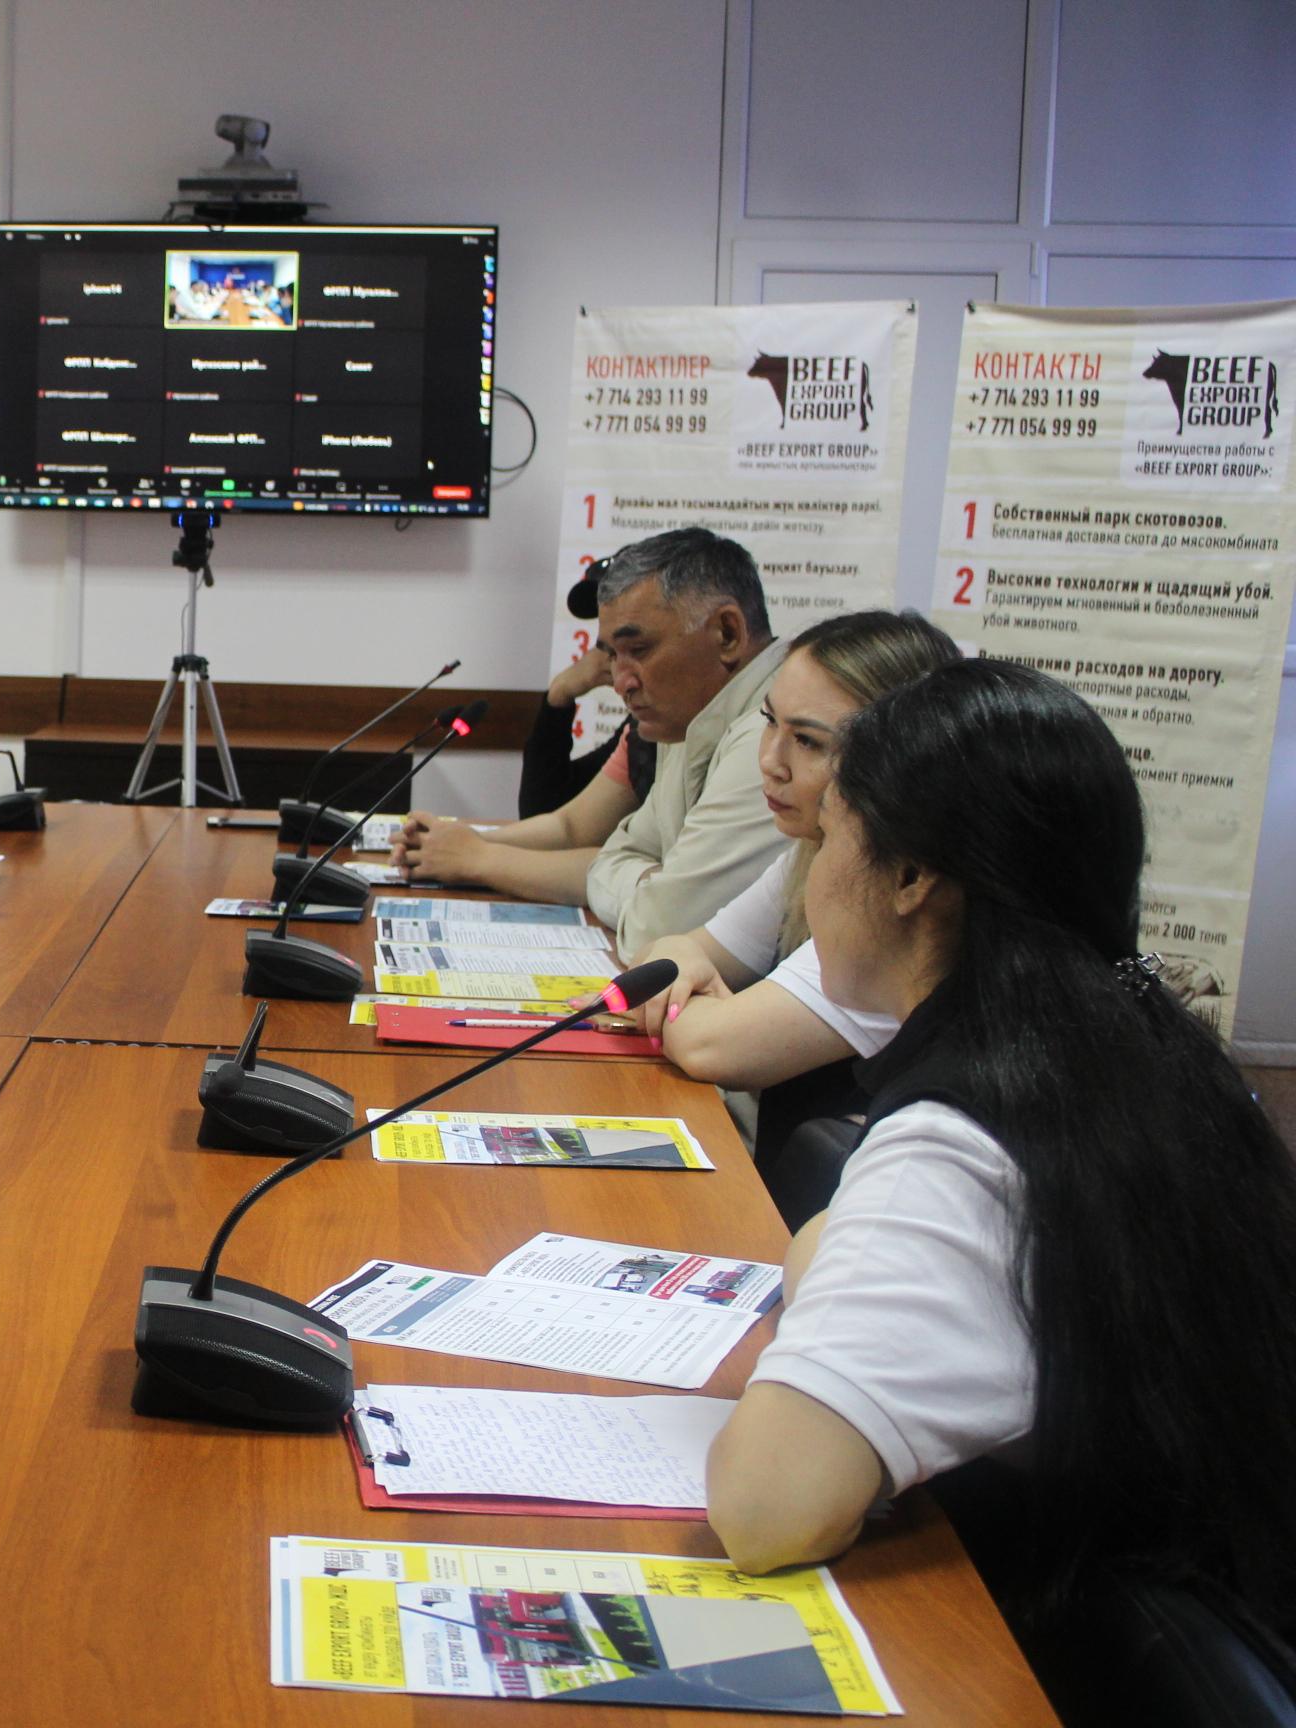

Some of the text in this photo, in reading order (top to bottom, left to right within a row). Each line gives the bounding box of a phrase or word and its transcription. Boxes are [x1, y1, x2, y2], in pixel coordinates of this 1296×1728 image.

[586, 354, 711, 379] КОНТАКТІЛЕР
[792, 356, 857, 381] BEEF
[974, 353, 1102, 381] КОНТАКТЫ
[1192, 356, 1263, 384] BEEF
[585, 388, 708, 406] +7 714 293 11 99
[791, 384, 856, 399] EXPORT
[970, 389, 1100, 407] +7 714 293 11 99
[1189, 387, 1262, 404] EXPORT
[790, 402, 856, 420] GROUP
[1187, 406, 1261, 427] GROUP
[584, 415, 707, 433] +7 771 054 99 99
[966, 418, 1097, 436] +7 771 054 99 99
[737, 443, 879, 458] «BEEF EXPORT GROUP»
[1137, 441, 1275, 461] Преимущества работы с
[1135, 462, 1170, 476] «BEEF
[1175, 462, 1218, 476] EXPORT
[584, 494, 596, 529] 1
[964, 502, 977, 539] 1
[994, 502, 1228, 529] Собственный парк скотовозов.
[992, 526, 1278, 551] Бесплатная доставка скота до мясокомбината
[952, 567, 975, 605] 2
[987, 568, 1274, 603] Высокие технологии и щадящий убой.
[985, 590, 1259, 620] Гарантируем мгновенный и безболезненный
[983, 612, 1080, 634] убой животного.
[1075, 659, 1144, 677] расходов
[1149, 664, 1166, 679] на
[1170, 667, 1225, 686] дорогу.
[1064, 680, 1190, 702] нспортные расходы,
[1132, 706, 1139, 718] и
[1181, 770, 1234, 788] приемки
[1162, 922, 1171, 938] 2
[1173, 923, 1196, 941] 000
[1200, 929, 1228, 945] тенге
